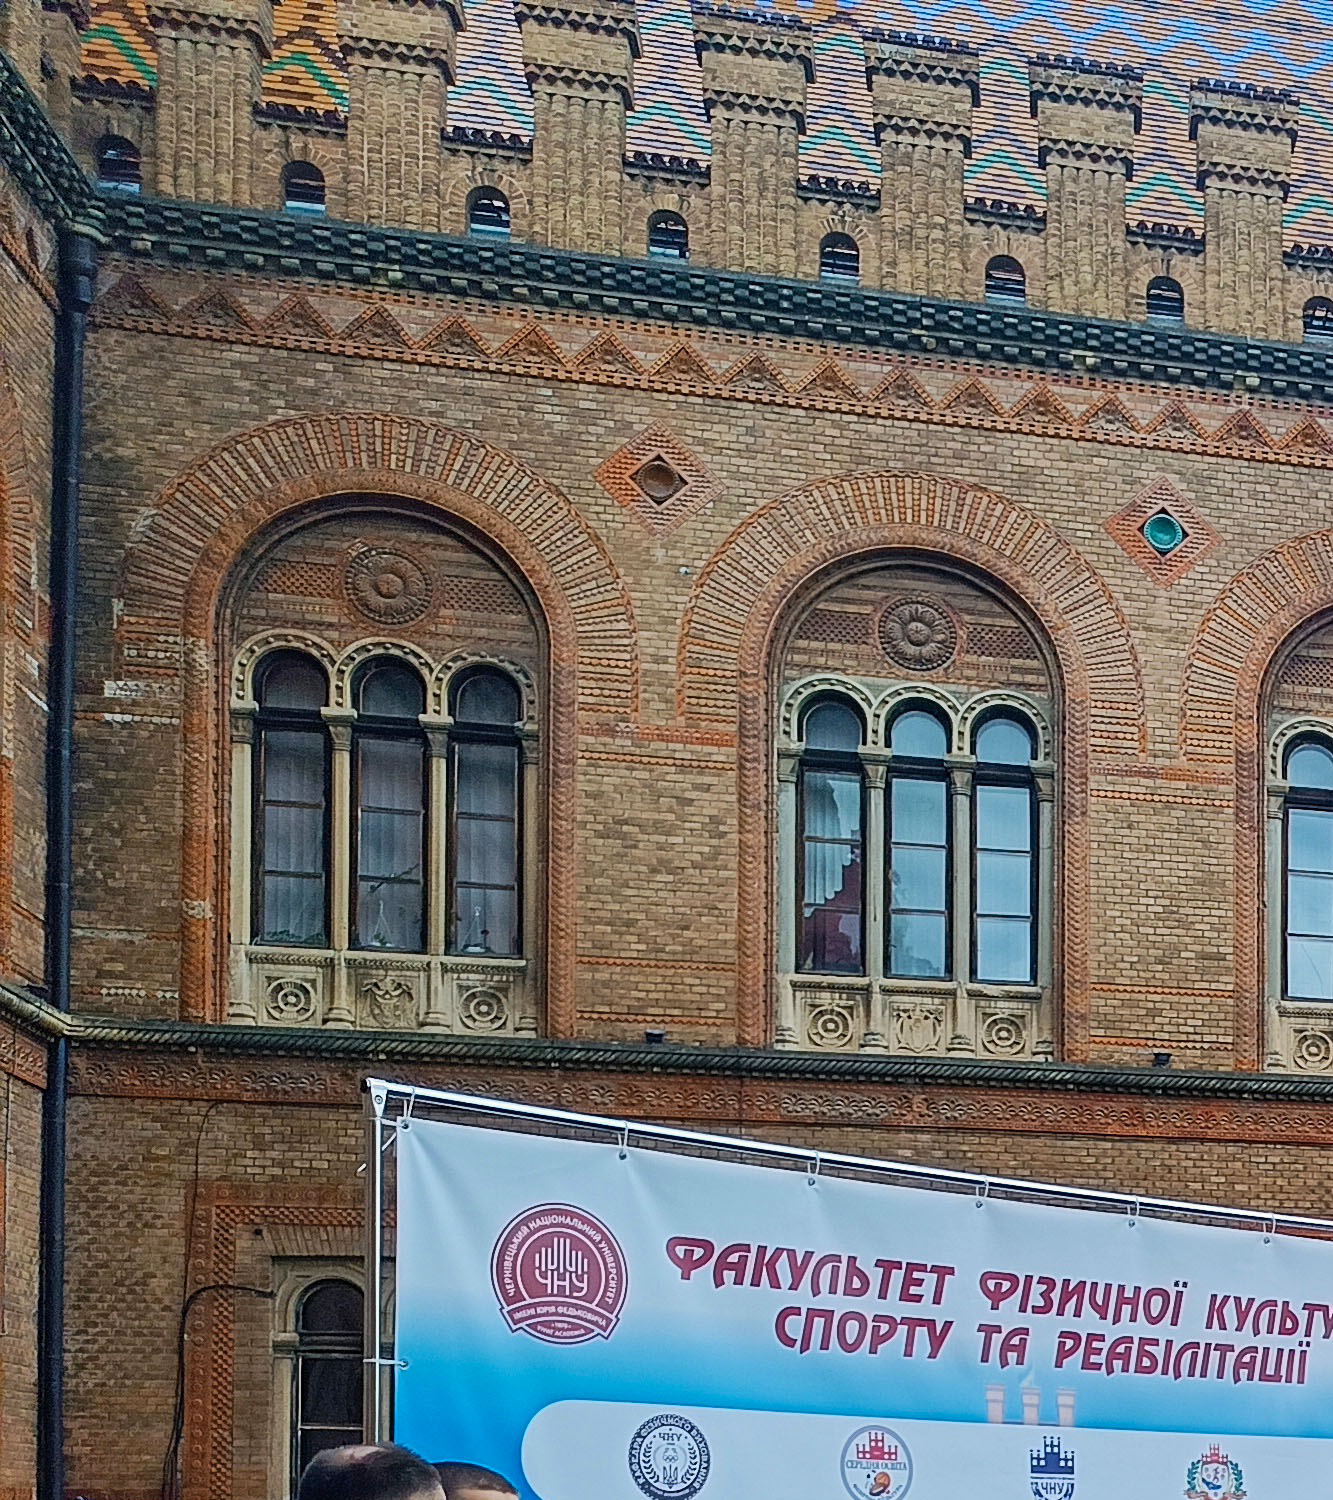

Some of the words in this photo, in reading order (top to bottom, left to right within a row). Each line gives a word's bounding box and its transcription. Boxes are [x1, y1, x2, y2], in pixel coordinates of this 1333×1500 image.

[503, 1225, 529, 1297] ЧЕРНІВЕЦЬКИЙ
[528, 1214, 602, 1243] НАЦІОНАЛЬНИЙ
[598, 1240, 618, 1304] УНІВЕРСИТЕТ
[535, 1269, 588, 1297] ЧНУ
[665, 1235, 956, 1306] ФАКУЛЬТЕТ
[978, 1270, 1189, 1327] ФІЗИЧНОЇ
[774, 1305, 954, 1359] СПОРТУ
[976, 1323, 1030, 1369] ТА
[1054, 1330, 1311, 1386] РЕАБІЛІТАЦІЇ
[659, 1432, 682, 1442] ЧНУ
[1041, 1482, 1065, 1495] ЧНУ
